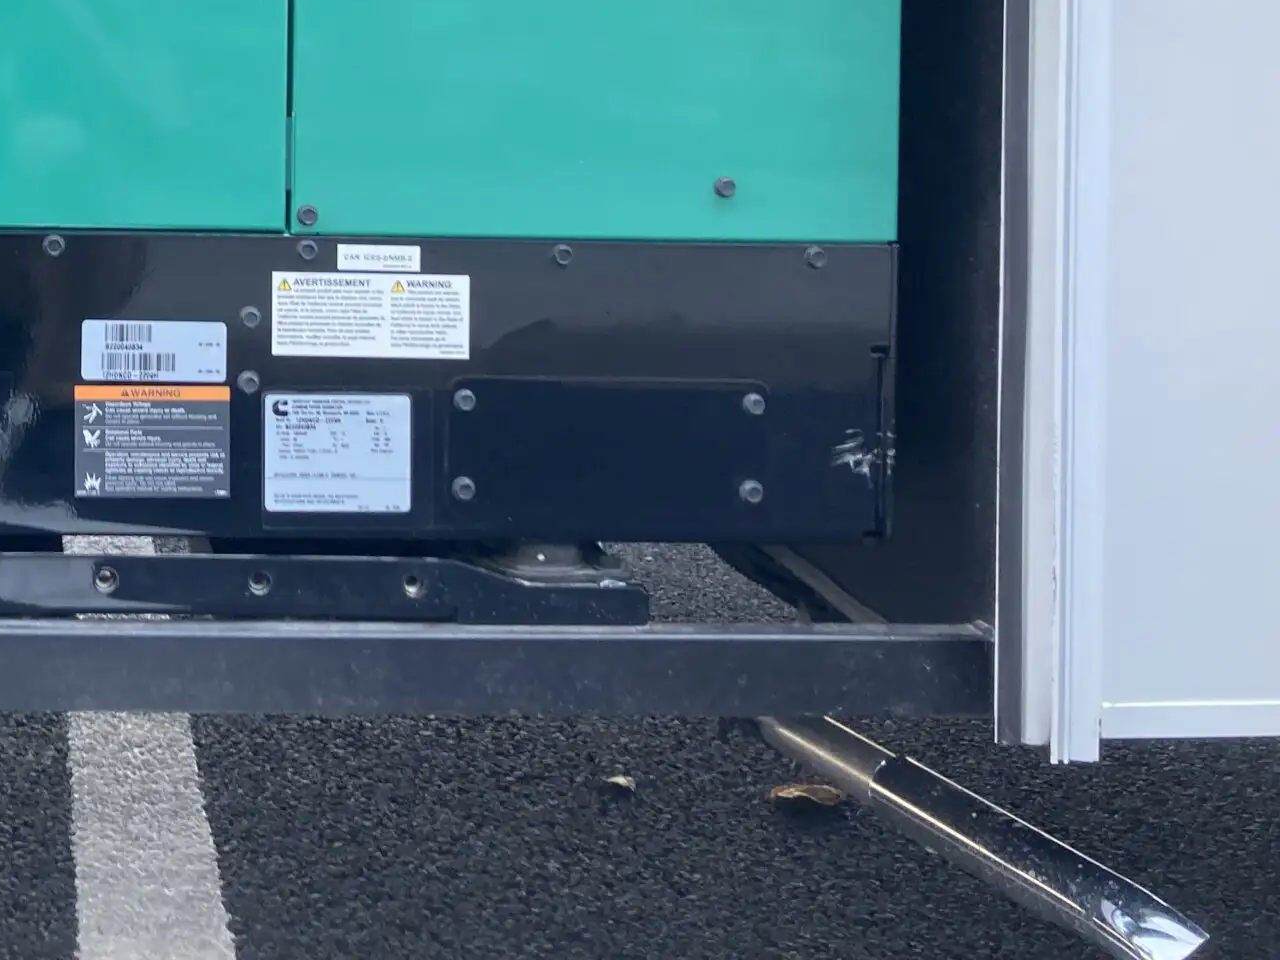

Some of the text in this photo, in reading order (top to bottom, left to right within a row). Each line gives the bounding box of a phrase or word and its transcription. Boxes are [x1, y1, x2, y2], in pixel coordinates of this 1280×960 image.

[293, 277, 371, 288] AVERTISSEMENT
[406, 279, 452, 289] WARNING
[129, 389, 181, 398] WARNING
